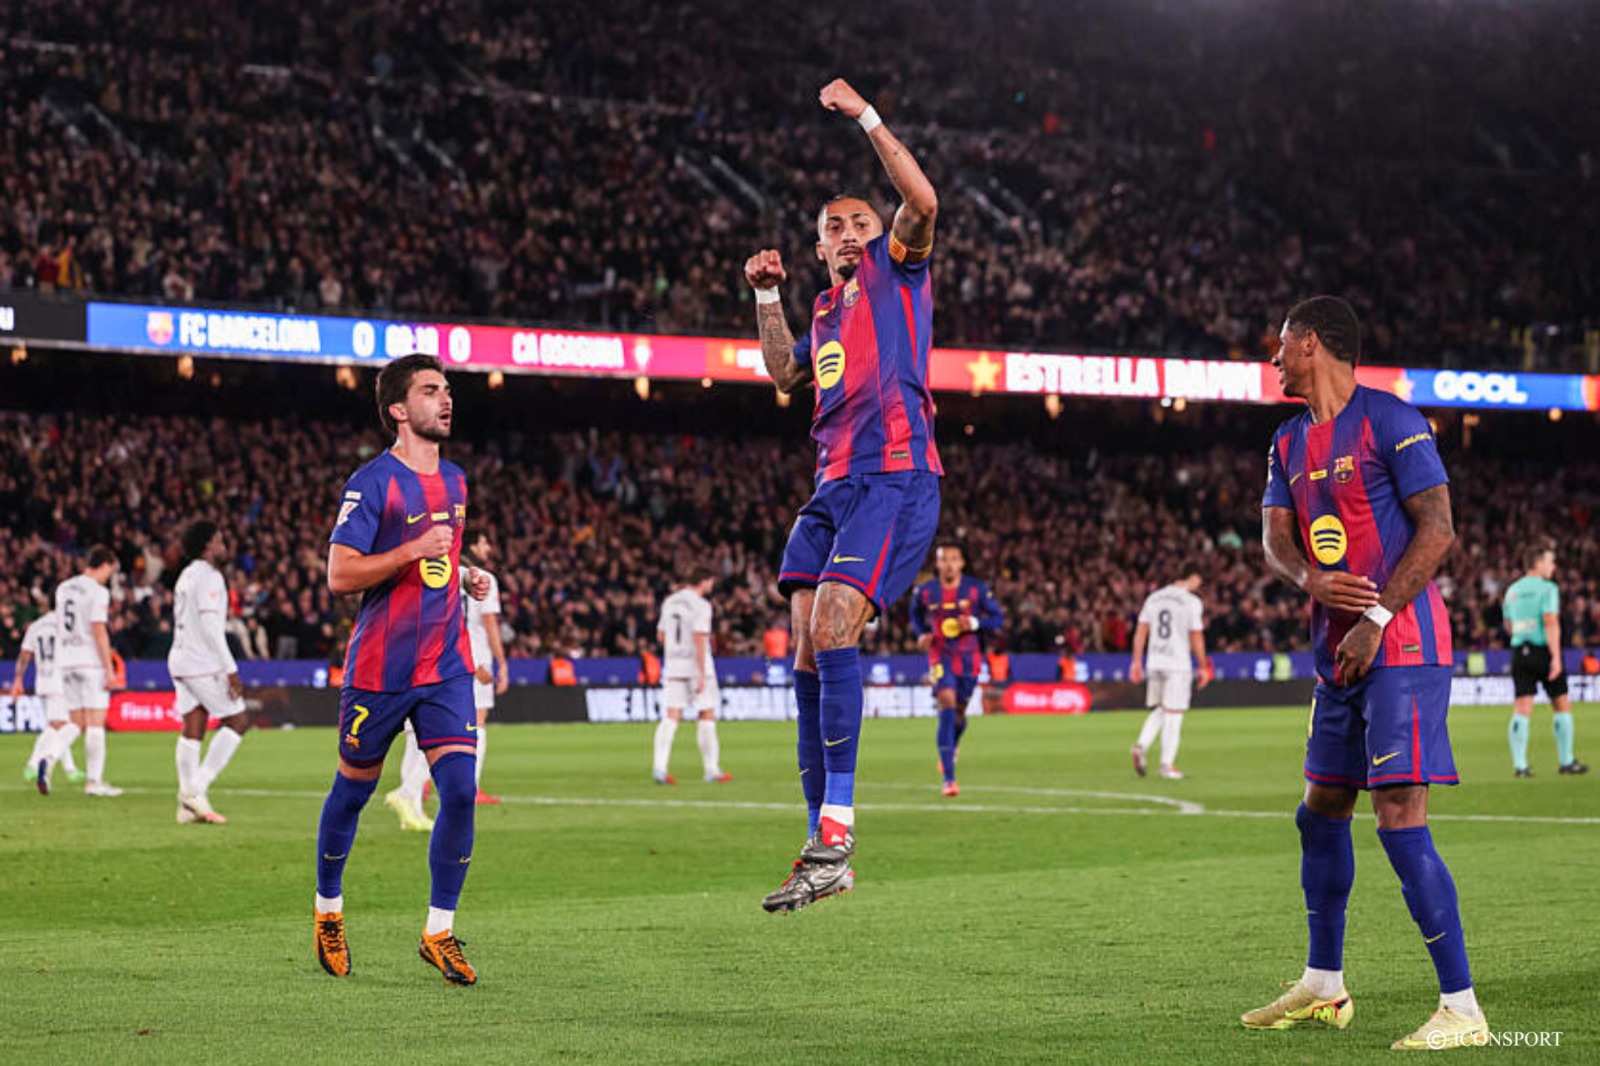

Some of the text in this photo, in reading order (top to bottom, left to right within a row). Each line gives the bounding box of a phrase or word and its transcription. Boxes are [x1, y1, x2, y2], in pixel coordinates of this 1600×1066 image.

[180, 313, 320, 352] FC BARCELONA
[353, 321, 375, 357] 0
[449, 327, 471, 362] 0
[1006, 353, 1159, 395] ESTRELLA
[1157, 608, 1172, 640] 8
[37, 635, 56, 661] 14
[352, 704, 370, 736] 7
